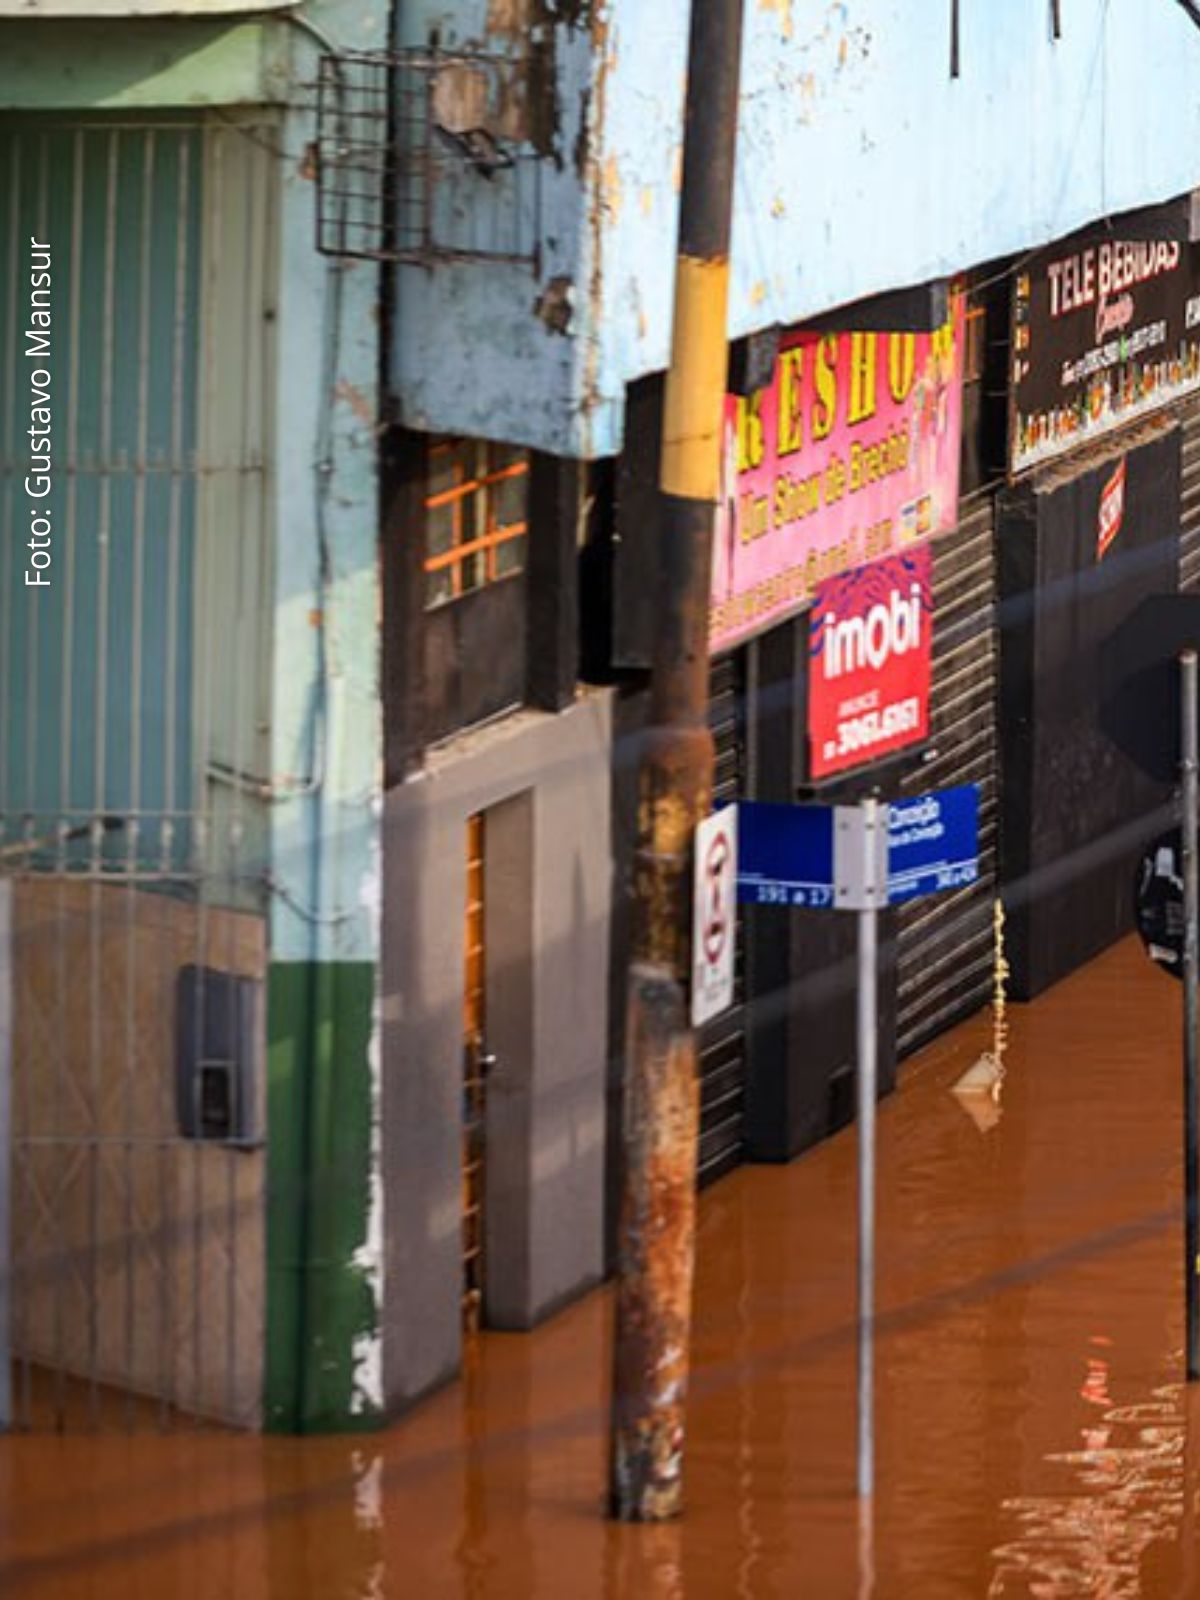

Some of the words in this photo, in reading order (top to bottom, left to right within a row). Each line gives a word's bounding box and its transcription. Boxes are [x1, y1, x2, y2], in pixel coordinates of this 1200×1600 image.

[1047, 249, 1096, 317] TELE
[1098, 240, 1180, 296] BEBIDAS
[824, 583, 921, 679] imobi
